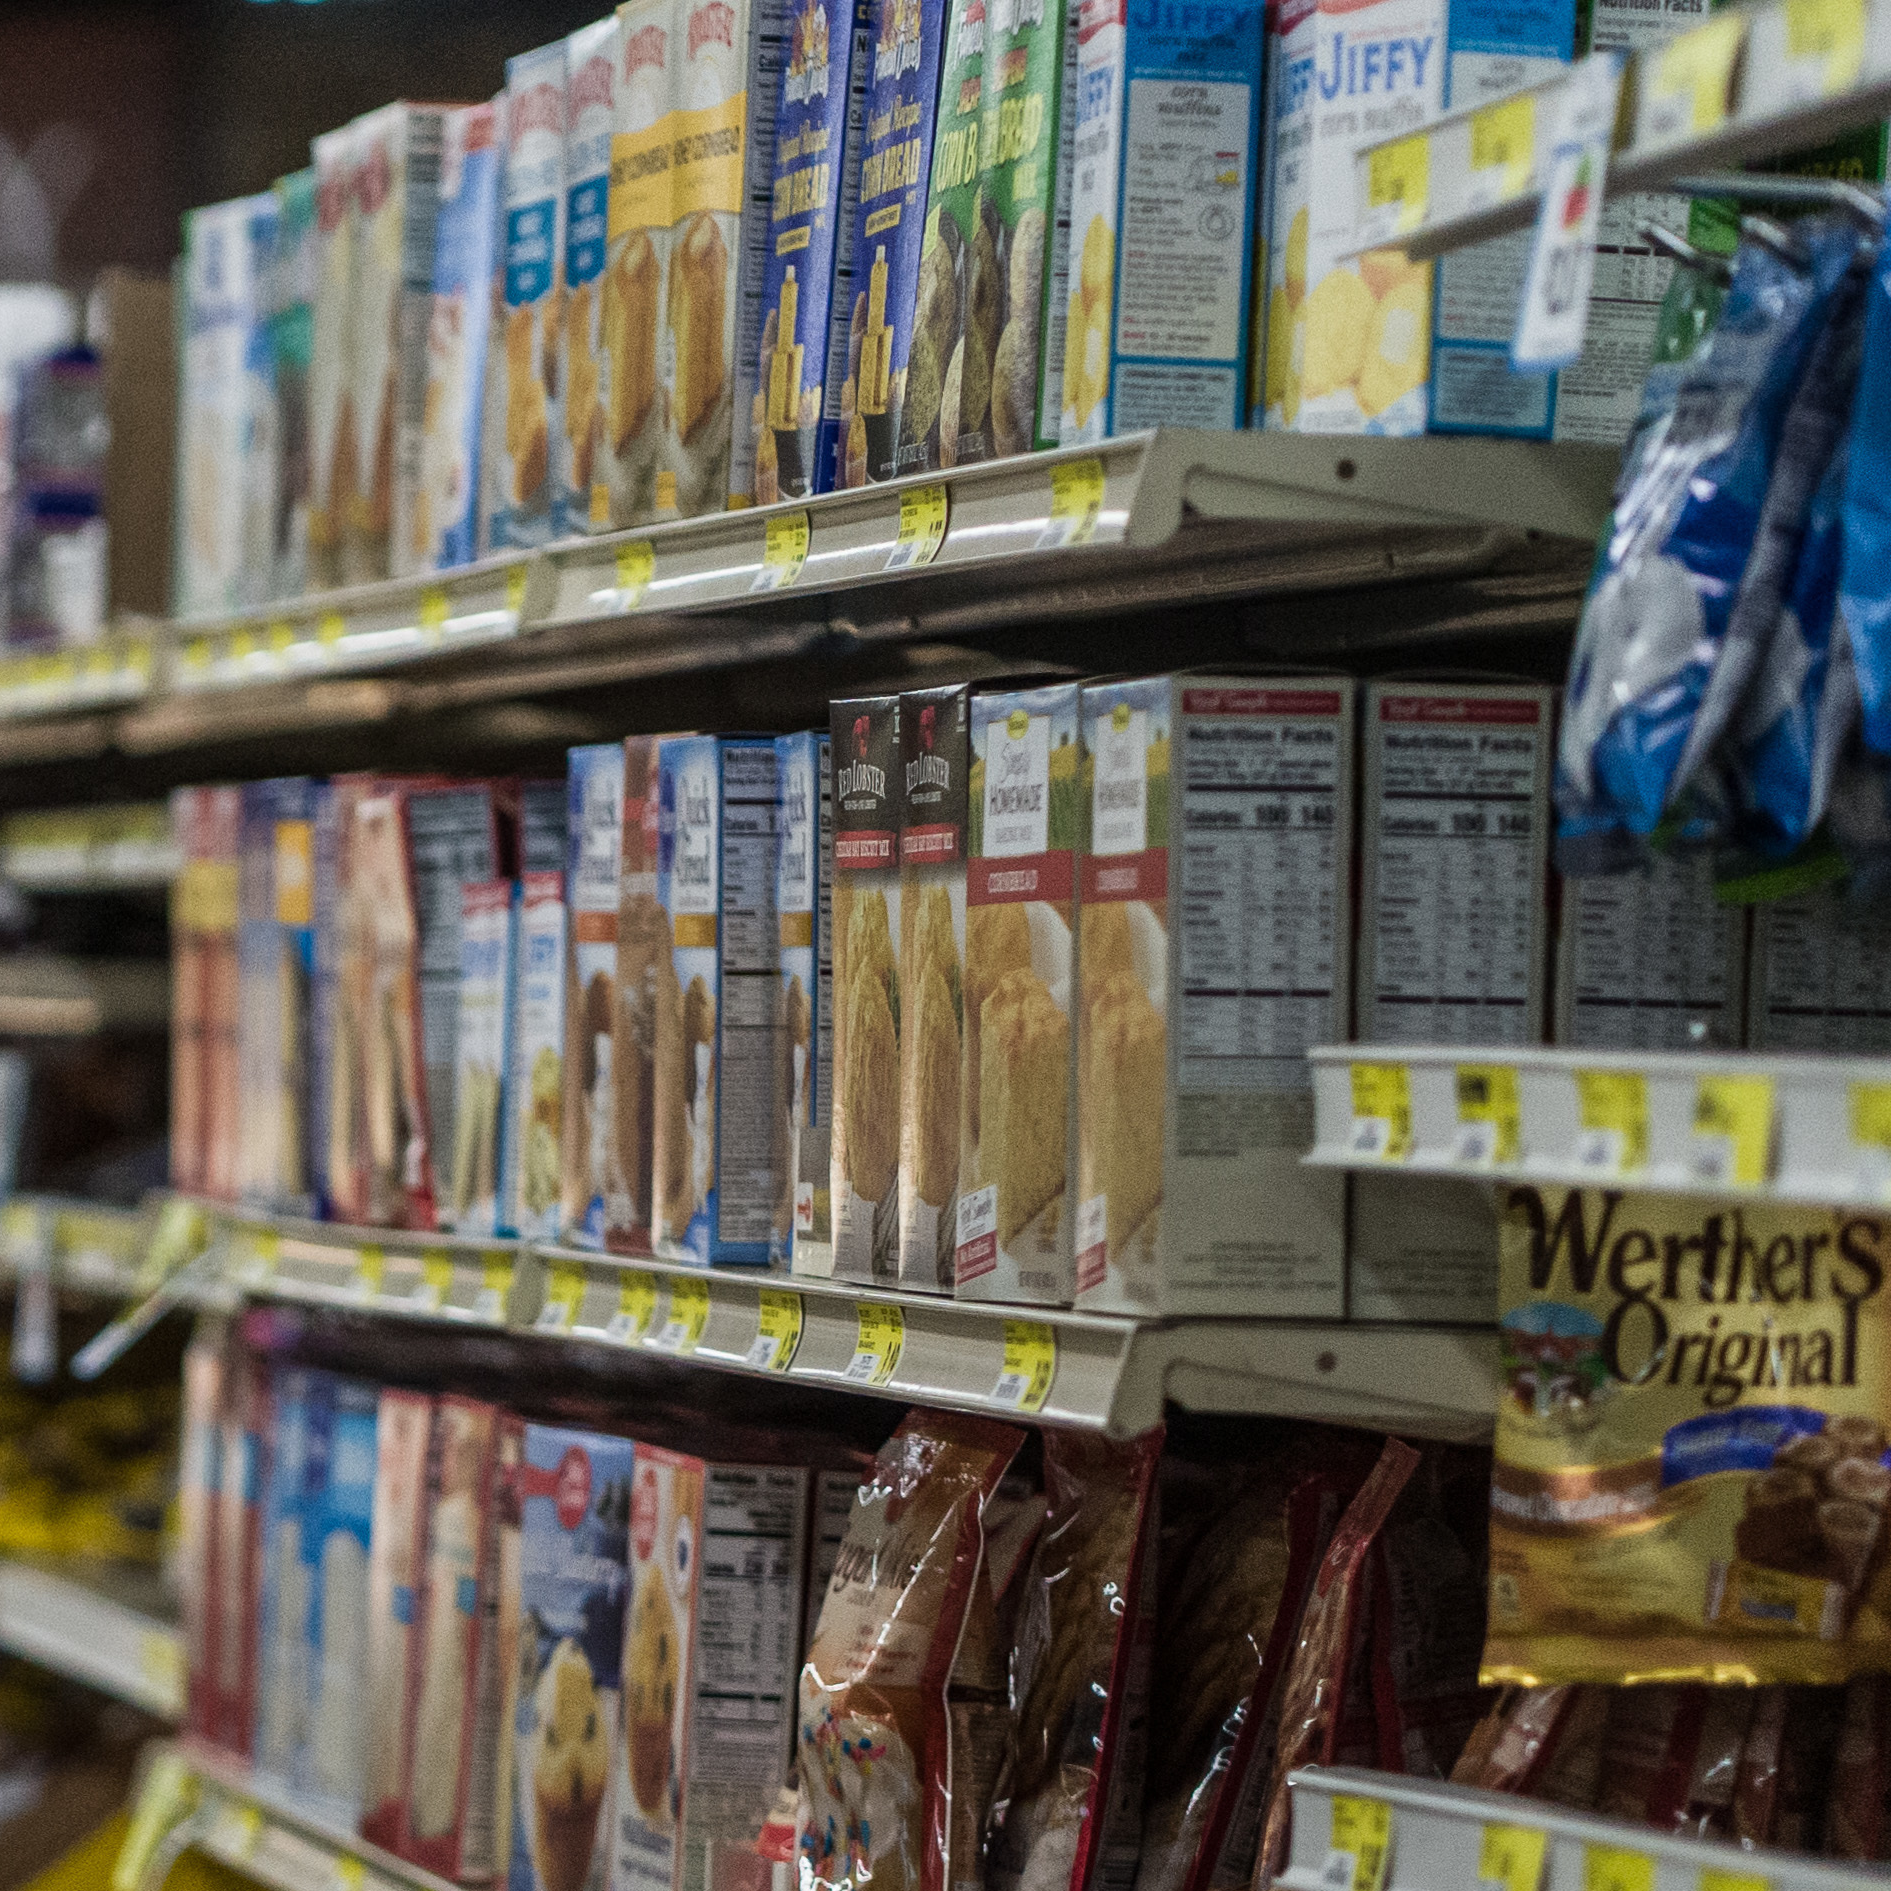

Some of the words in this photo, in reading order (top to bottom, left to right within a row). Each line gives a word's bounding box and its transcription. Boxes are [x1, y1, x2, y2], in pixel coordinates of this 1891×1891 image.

[1319, 32, 1435, 101] JIFFY
[851, 759, 887, 802] LOBSTER
[918, 750, 951, 791] LOBSTER
[1605, 1298, 1860, 1407] Original
